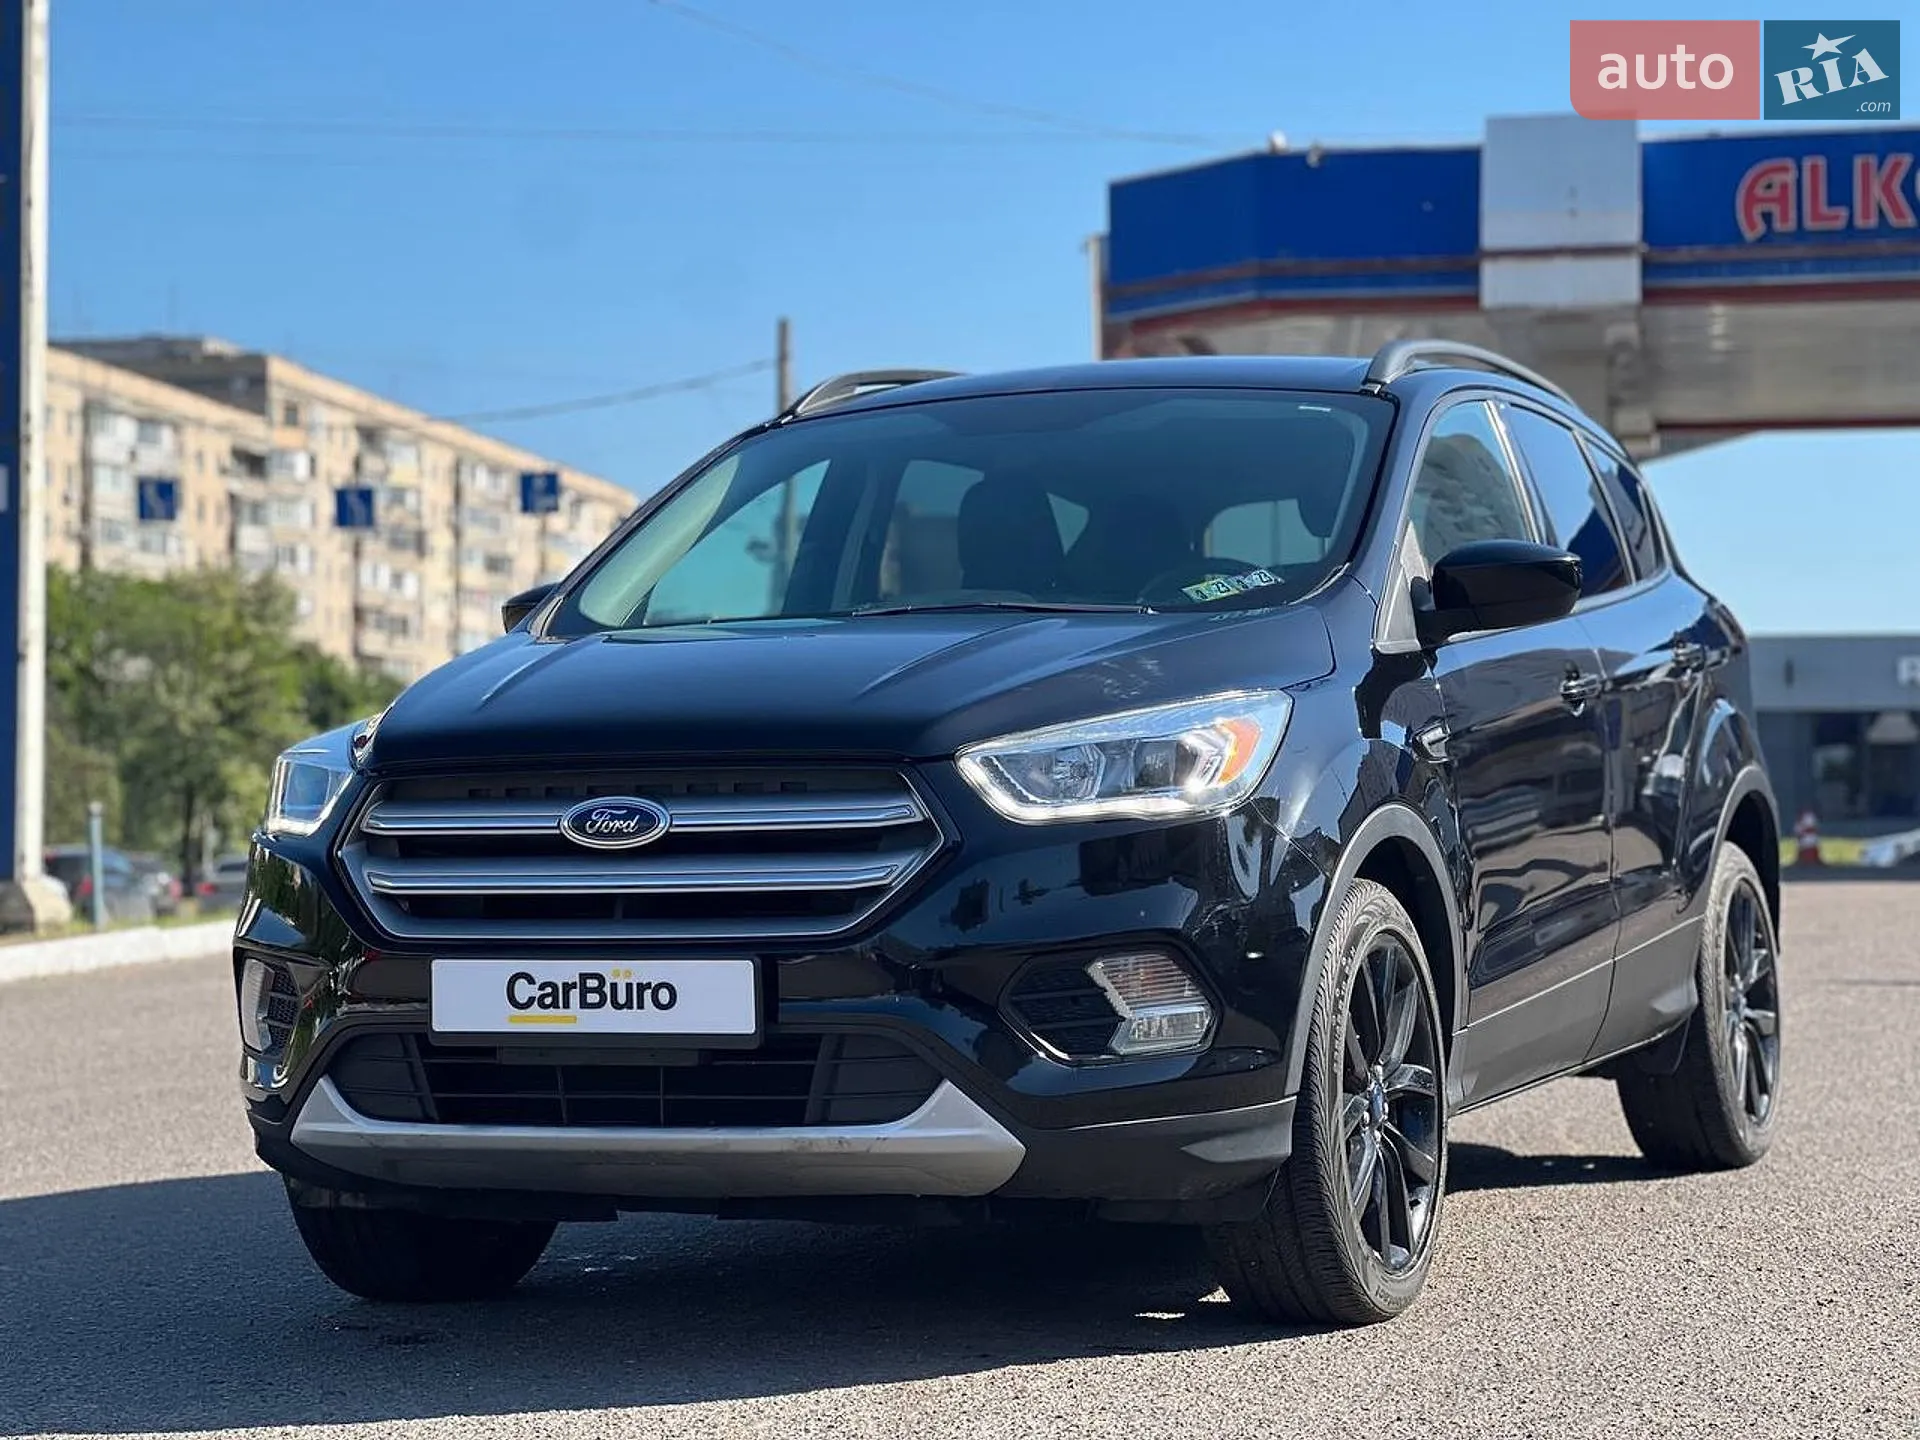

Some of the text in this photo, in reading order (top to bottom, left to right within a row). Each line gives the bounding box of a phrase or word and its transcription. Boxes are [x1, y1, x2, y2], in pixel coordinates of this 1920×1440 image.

[1736, 153, 1920, 243] ALK
[586, 808, 640, 834] Ford
[506, 968, 678, 1011] CarBüro
